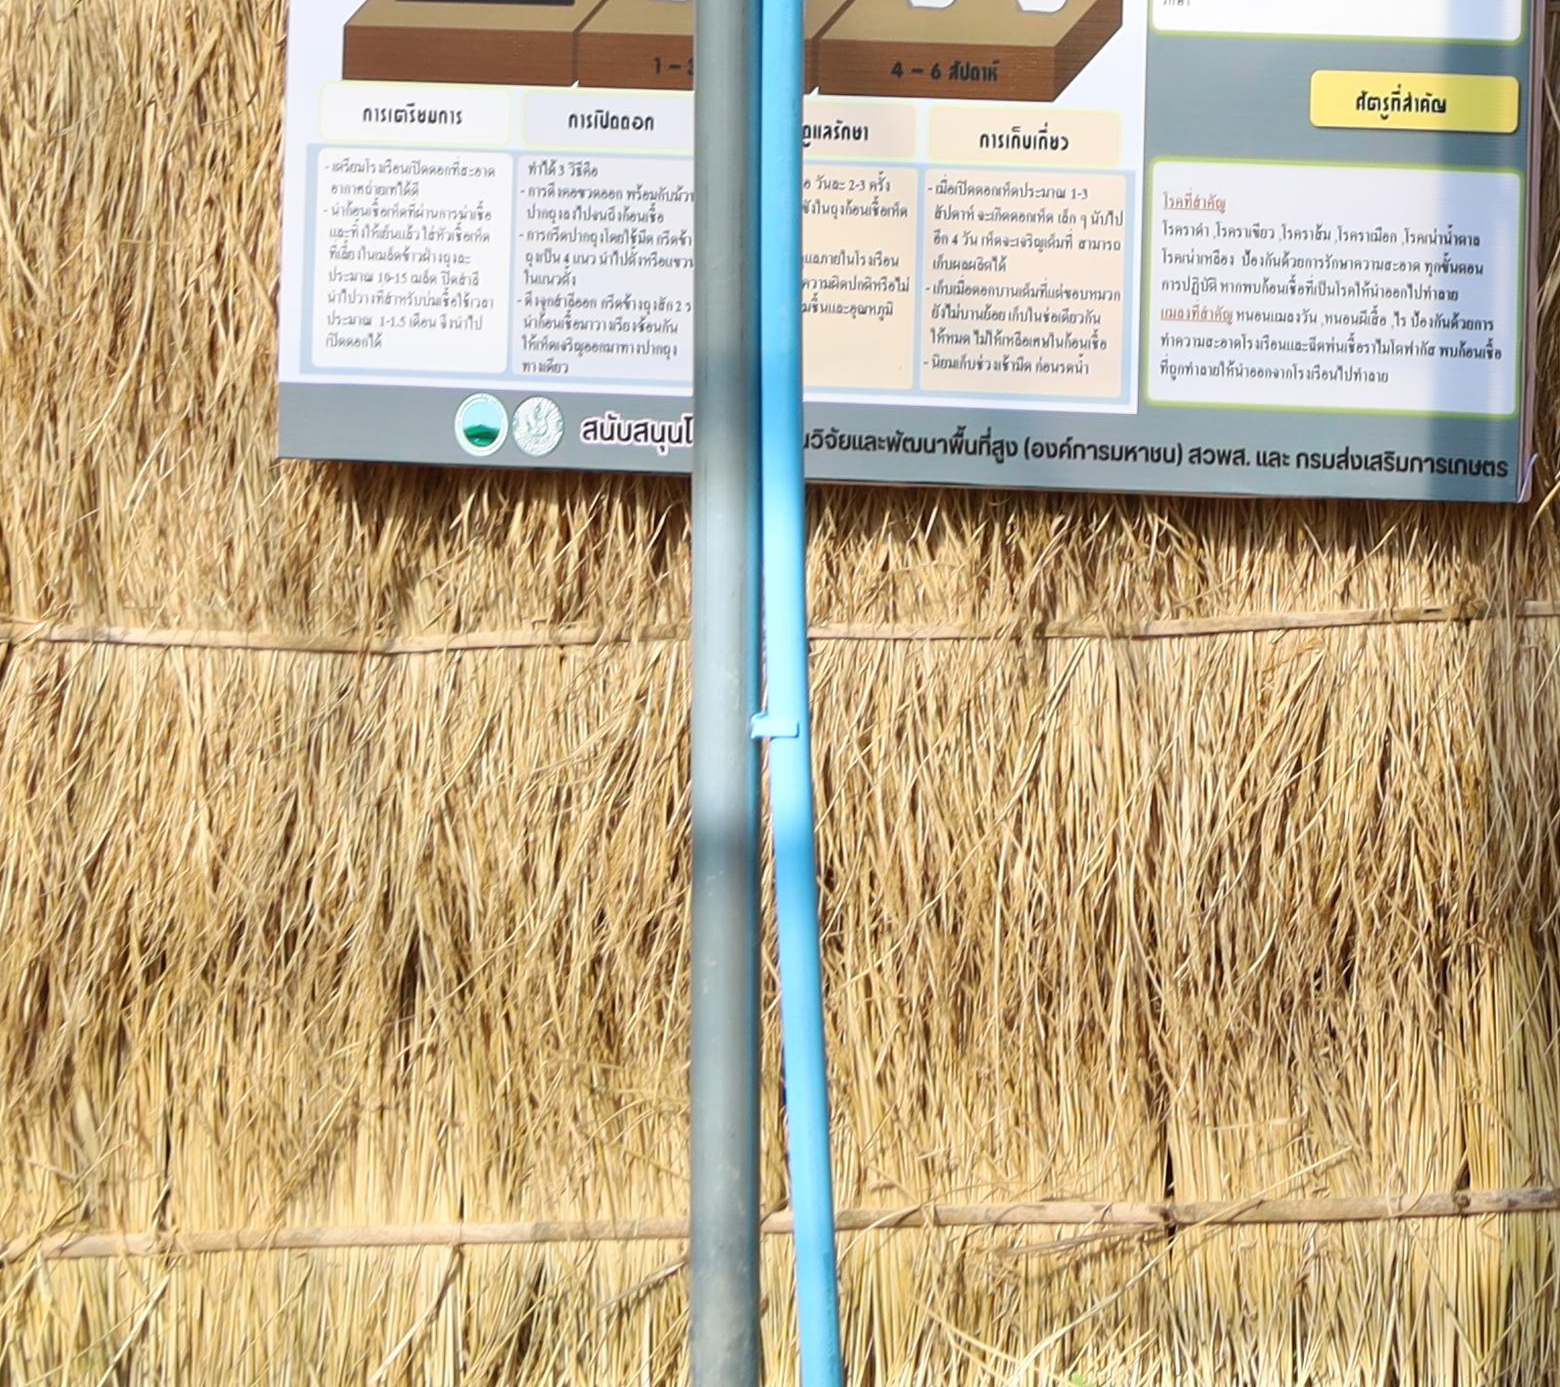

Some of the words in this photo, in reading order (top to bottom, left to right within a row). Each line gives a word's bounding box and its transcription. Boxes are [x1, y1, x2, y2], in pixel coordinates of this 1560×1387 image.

[949, 59, 1000, 82] สัปดาห์
[1356, 84, 1446, 119] ศัตรูที่สำคัญ
[363, 103, 462, 125] การเตรียมการ
[569, 110, 654, 130] การเปิดดอก
[980, 122, 1069, 150] การเก็บเกี่ยว
[558, 165, 565, 176] 3
[935, 204, 974, 221] สัปดาห์
[657, 229, 692, 246] กรีดข้า
[803, 249, 899, 268] แลภายในโรงเรือน
[802, 292, 893, 321] มชื้นและอุณหภูมิ
[582, 415, 693, 452] สนับสนุนโ
[1023, 431, 1183, 467] (องค์การมหาชน)
[1188, 444, 1251, 468] สวพส.
[1255, 446, 1290, 469] และ
[1296, 444, 1509, 478] กรมส่งเสริมการเกษตร
